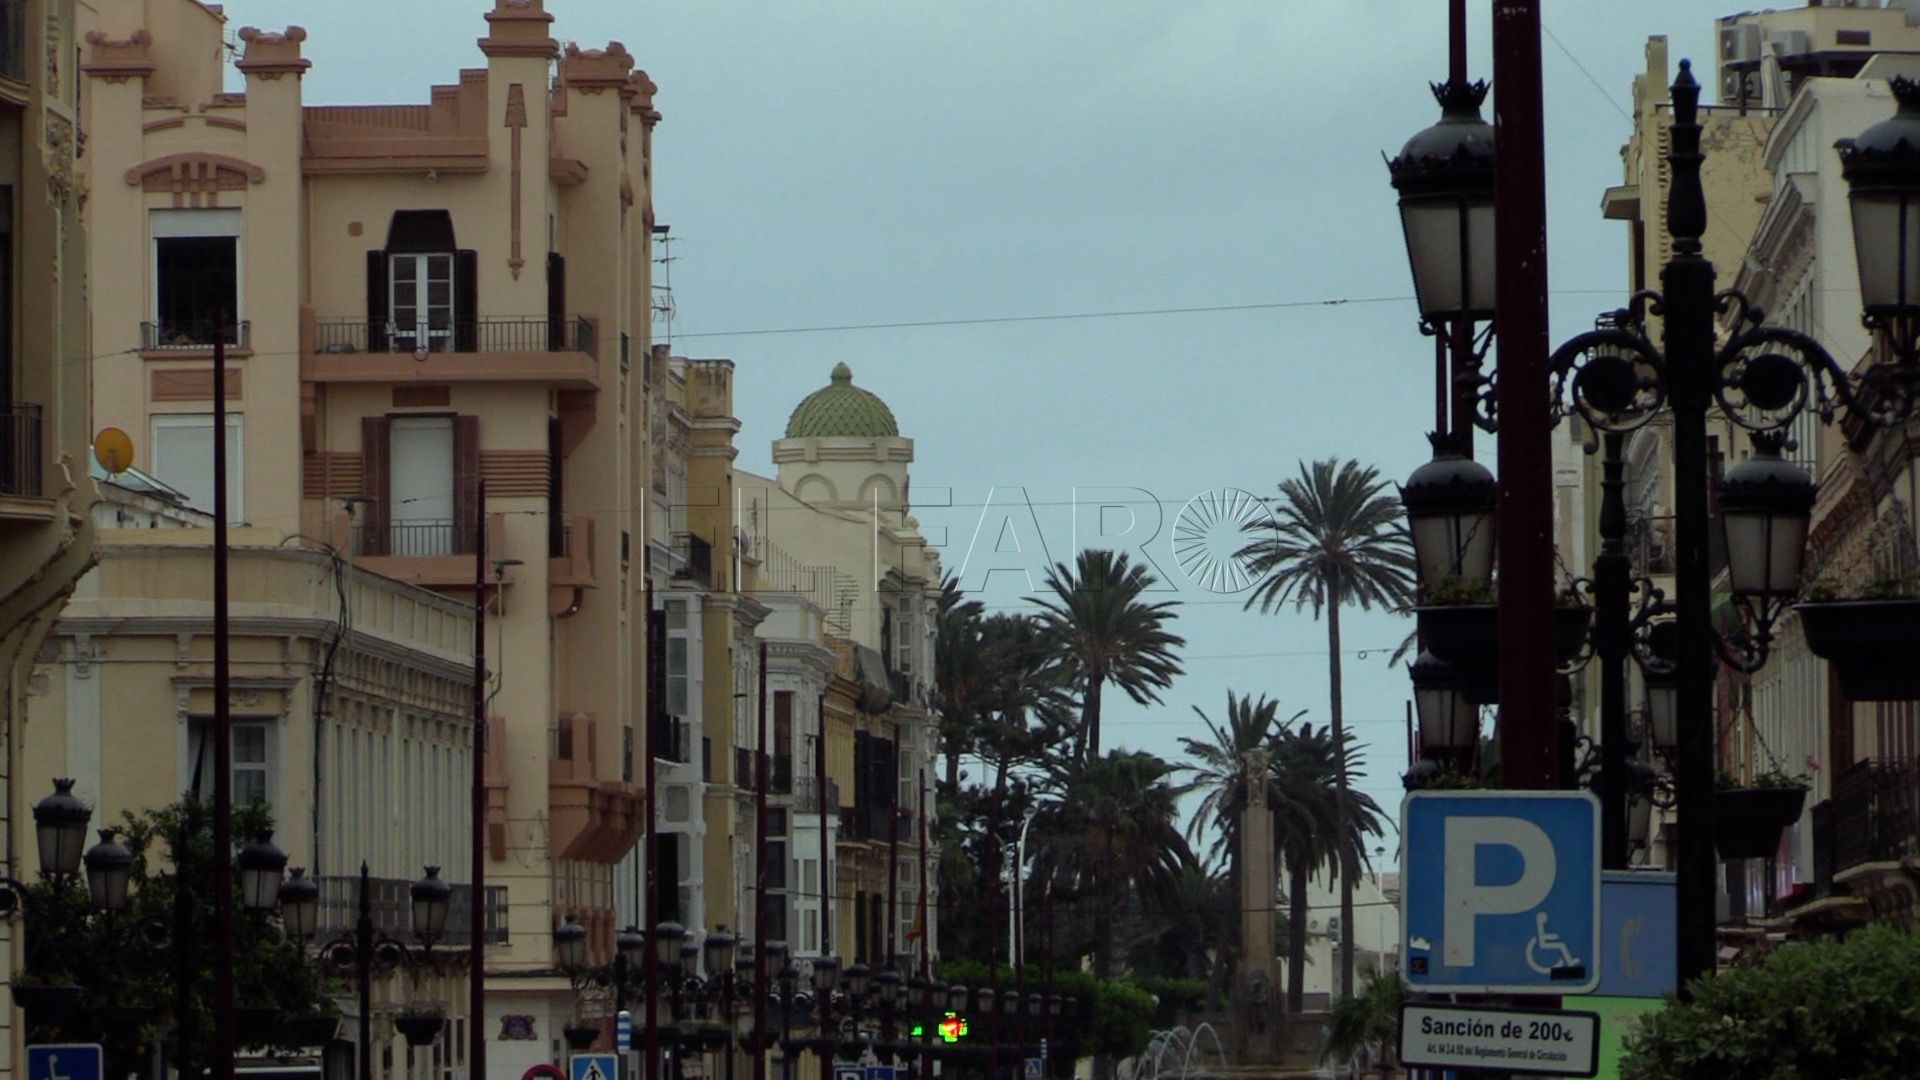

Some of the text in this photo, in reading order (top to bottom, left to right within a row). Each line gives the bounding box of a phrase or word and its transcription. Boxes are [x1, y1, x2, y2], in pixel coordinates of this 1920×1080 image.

[1444, 816, 1556, 967] P
[1421, 1015, 1494, 1038] Sanción
[1501, 1020, 1522, 1039] de
